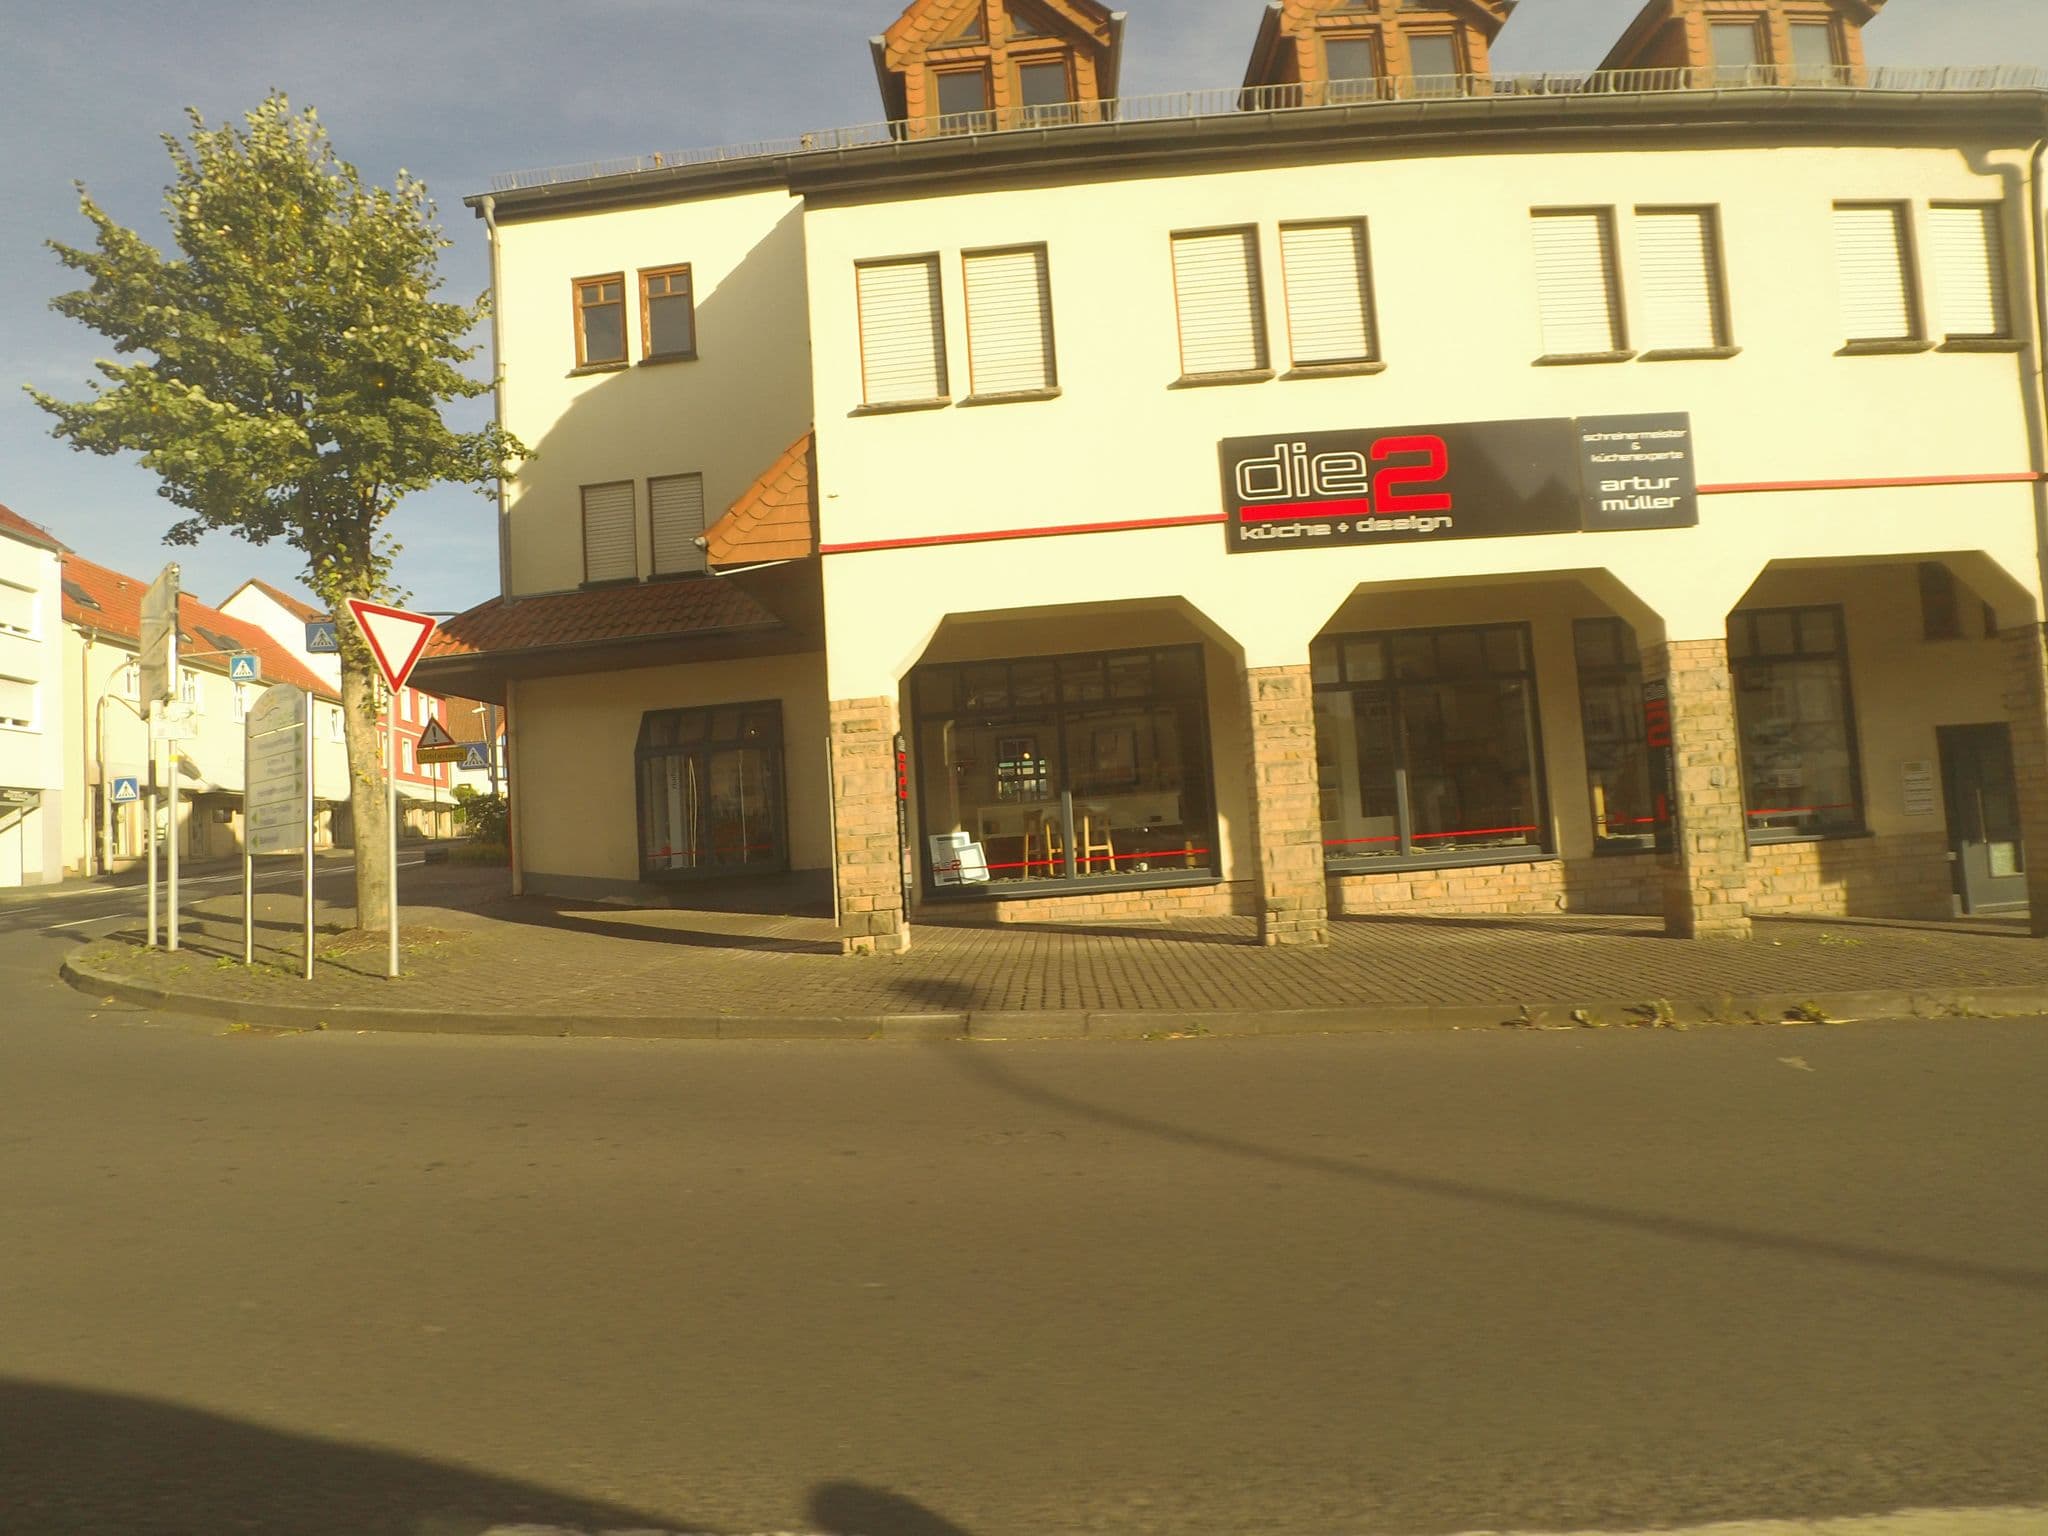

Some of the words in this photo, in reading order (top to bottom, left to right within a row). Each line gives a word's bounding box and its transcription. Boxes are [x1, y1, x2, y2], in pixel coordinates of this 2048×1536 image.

[1600, 476, 1680, 492] artur
[1601, 495, 1682, 512] müller
[1240, 523, 1332, 541] küche
[1355, 515, 1454, 533] design
